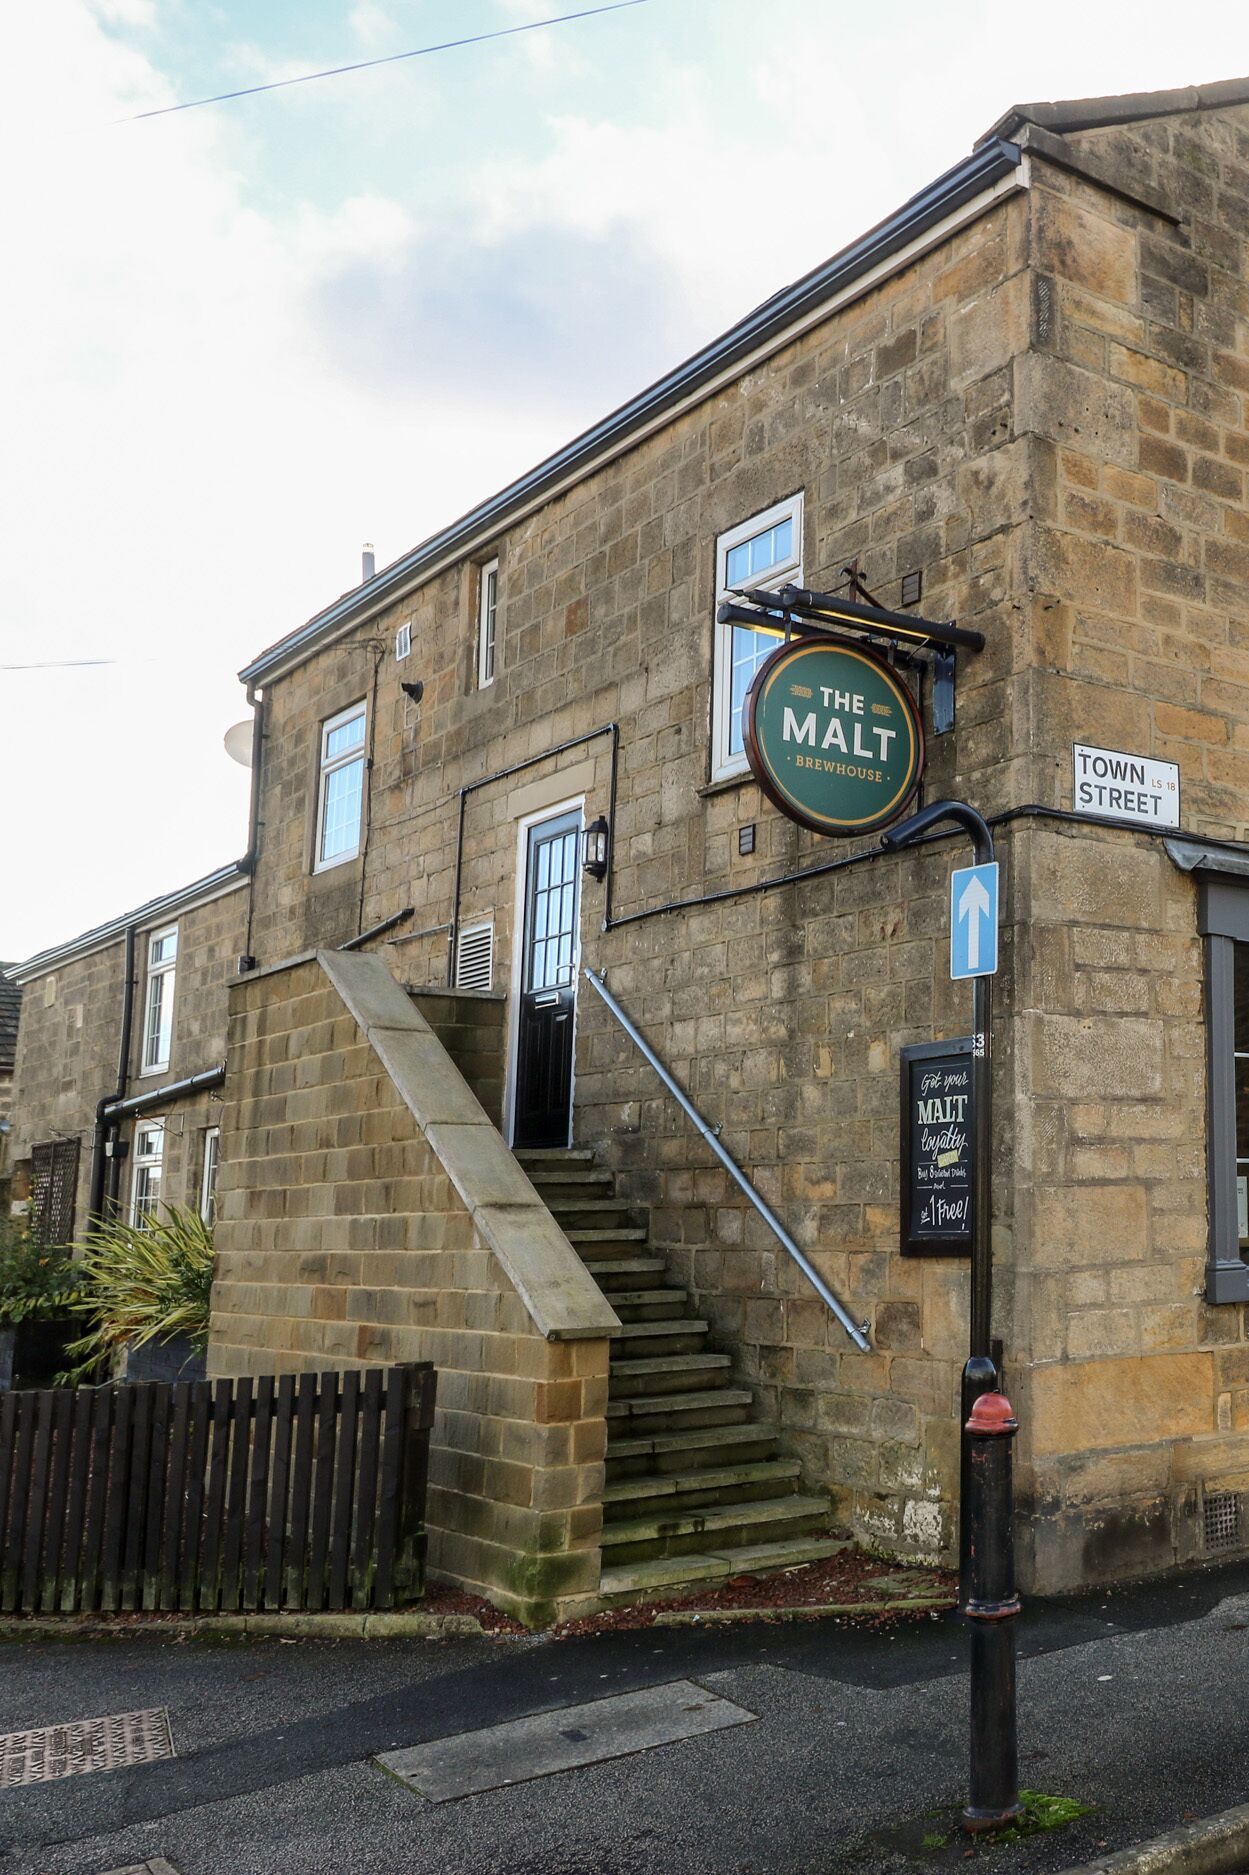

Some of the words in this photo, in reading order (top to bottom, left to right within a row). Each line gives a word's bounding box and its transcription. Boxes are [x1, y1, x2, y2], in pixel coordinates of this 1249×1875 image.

[819, 686, 865, 715] THE
[782, 706, 897, 762] MALT
[795, 755, 883, 783] BREWHOUSE
[1078, 753, 1145, 786] TOWN
[1151, 779, 1163, 789] LS
[1166, 782, 1176, 792] 18
[1079, 782, 1162, 816] STREET
[921, 1071, 942, 1097] Get
[943, 1071, 969, 1093] your
[917, 1095, 968, 1125] MALT
[921, 1123, 969, 1160] loyalty
[936, 1196, 969, 1230] Free!
